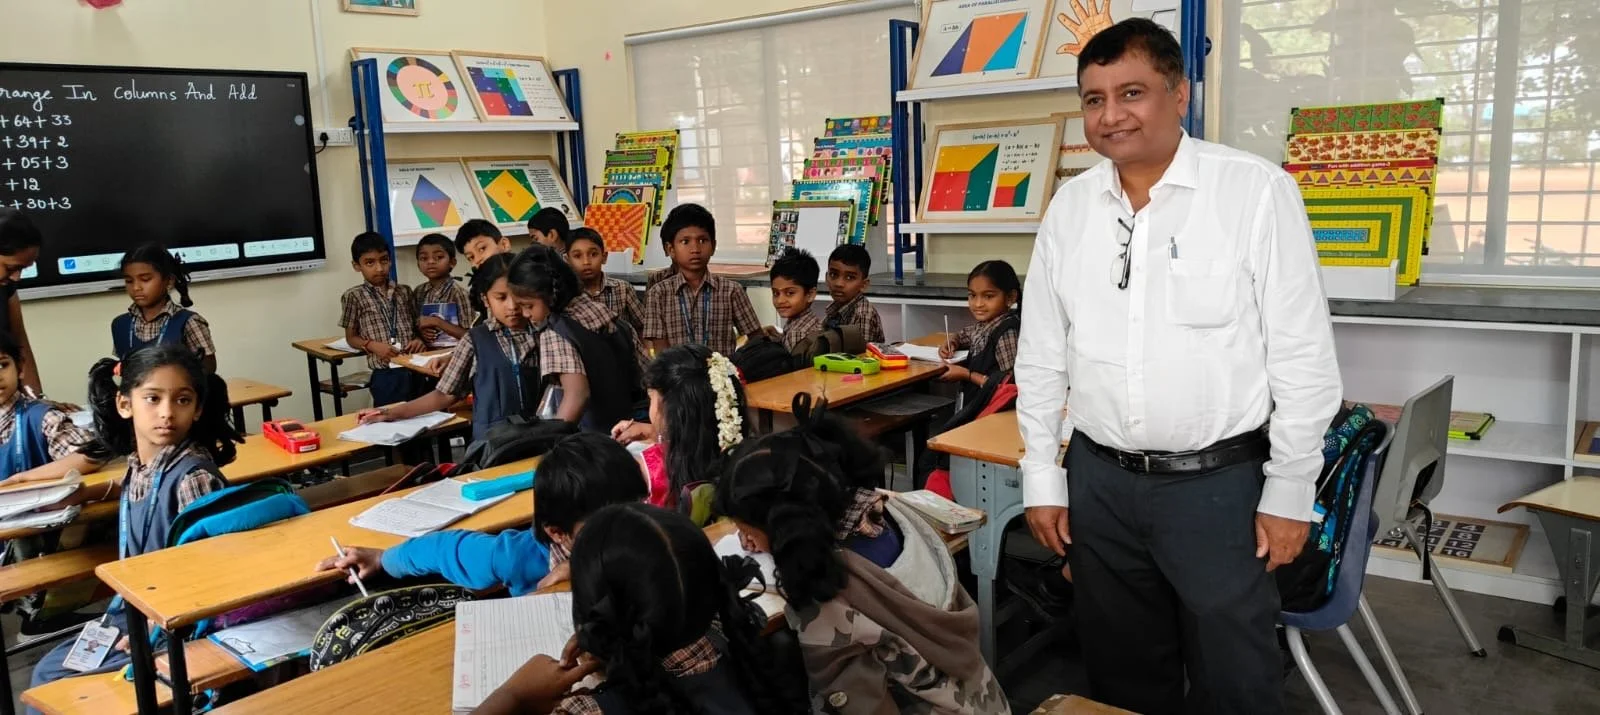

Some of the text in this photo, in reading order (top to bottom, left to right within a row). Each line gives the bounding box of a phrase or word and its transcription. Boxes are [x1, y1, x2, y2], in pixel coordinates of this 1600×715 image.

[61, 84, 97, 101] In
[184, 81, 217, 100] And
[228, 83, 258, 100] Add
[1457, 532, 1473, 540] 8
[1444, 549, 1468, 557] 16
